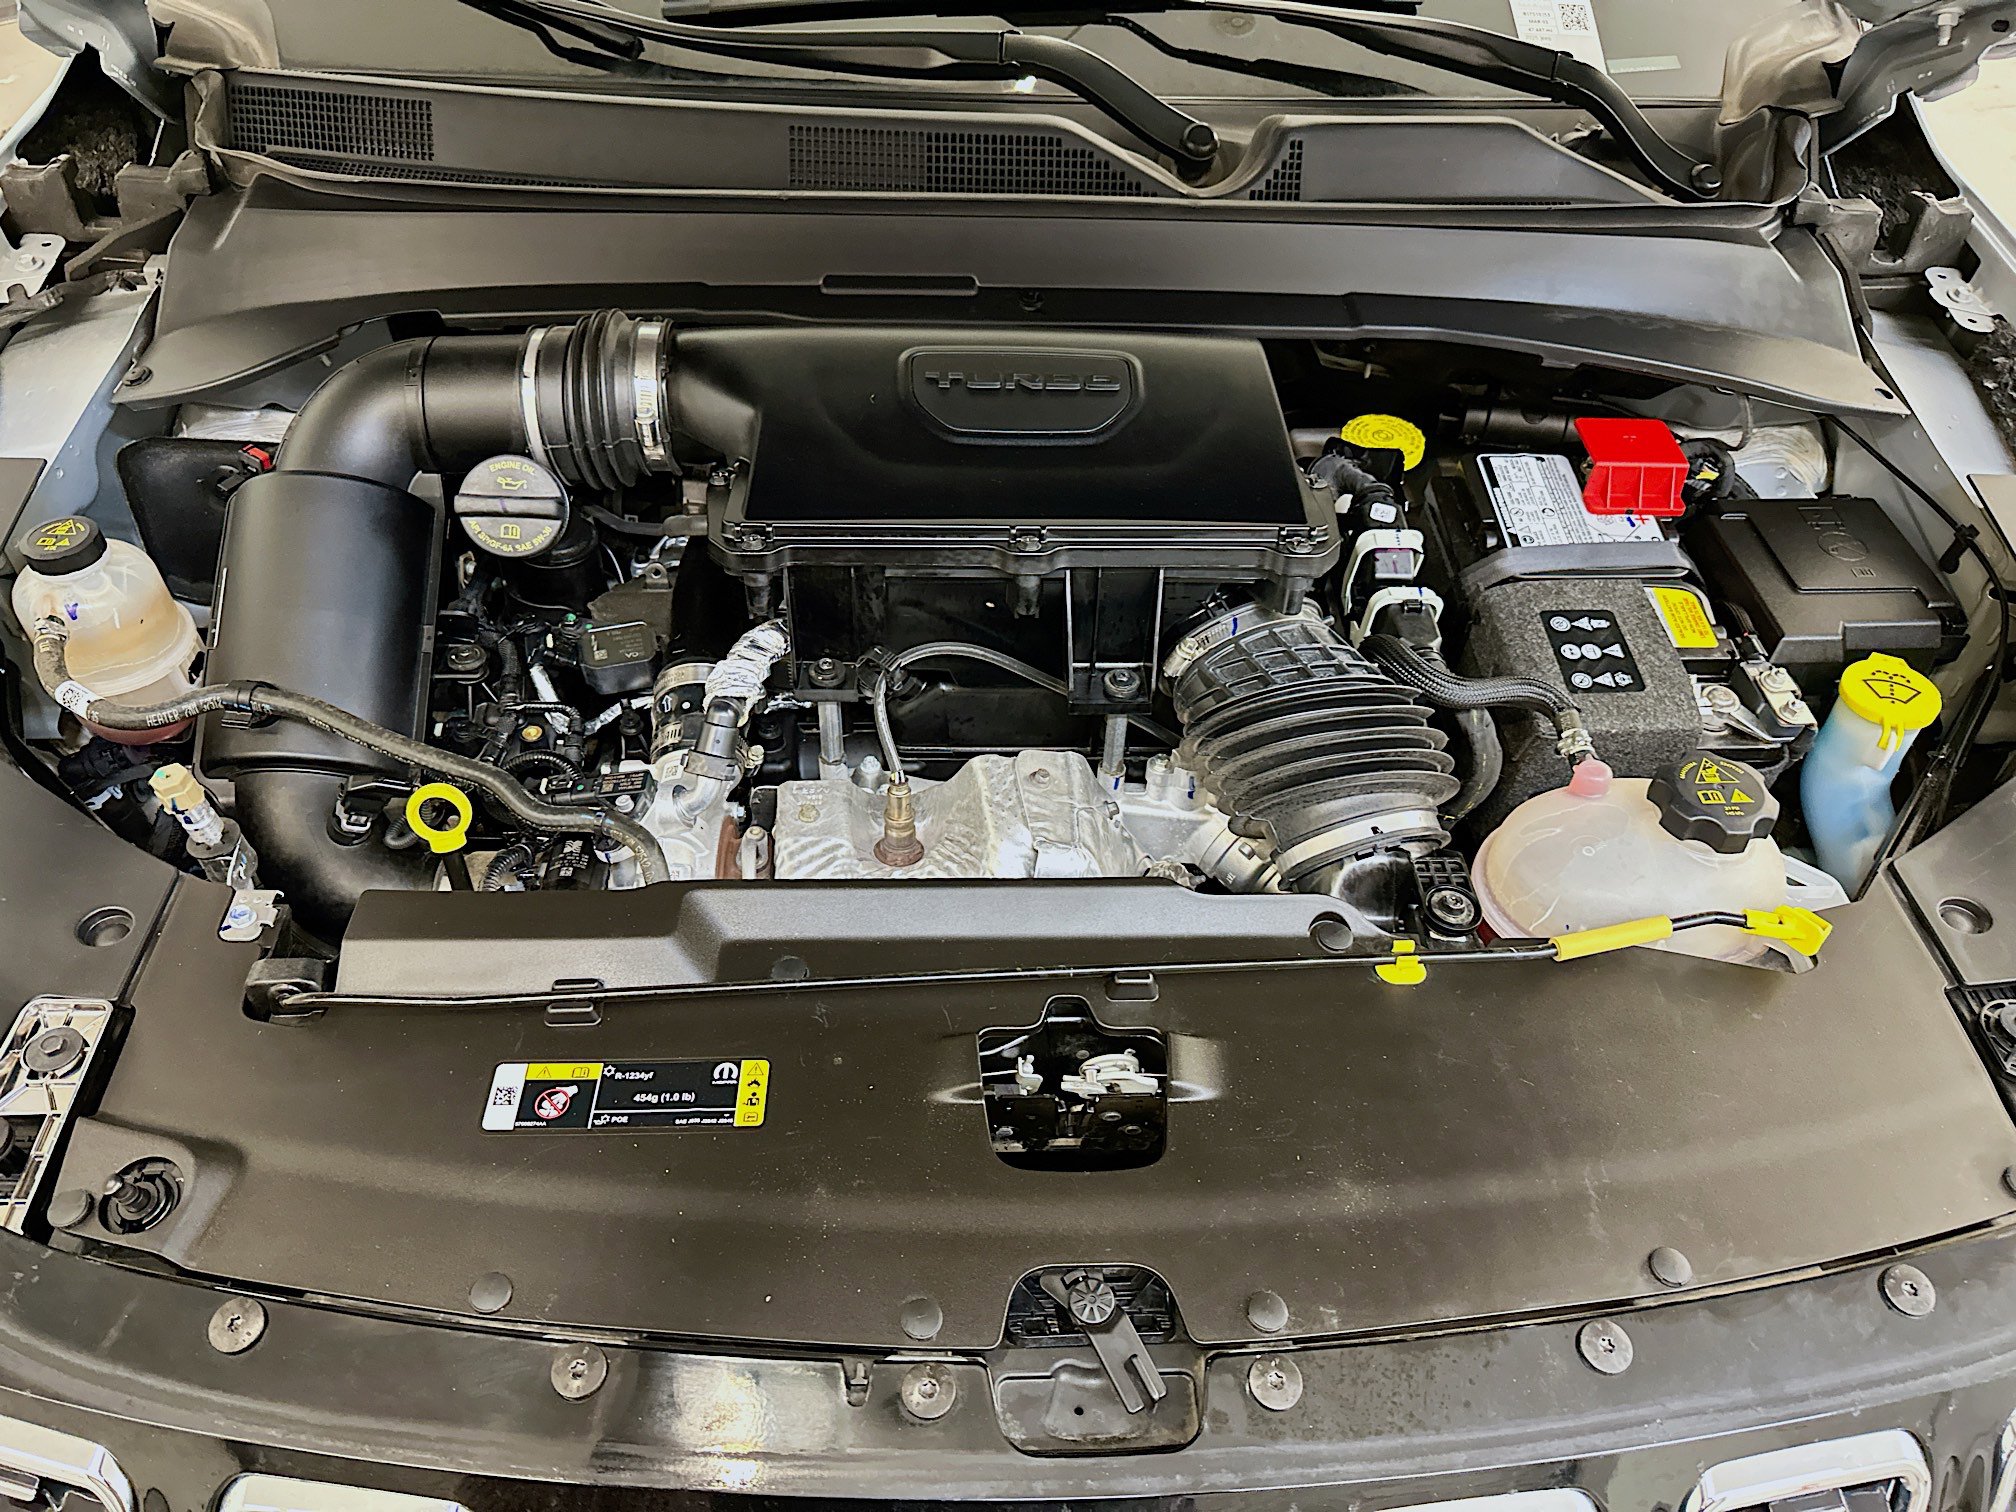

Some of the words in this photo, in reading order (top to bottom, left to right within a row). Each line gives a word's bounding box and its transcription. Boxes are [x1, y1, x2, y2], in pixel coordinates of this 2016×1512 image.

[924, 371, 1121, 391] TURBO
[488, 460, 521, 473] ENGINE
[521, 463, 536, 476] OIL
[468, 519, 481, 535] API
[515, 540, 534, 552] SAE
[145, 708, 180, 727] HEATER
[614, 1070, 654, 1081] R-1234yf
[633, 1093, 658, 1104] 454g
[660, 1092, 680, 1103] (1.0
[682, 1091, 696, 1103] lb)
[611, 1115, 628, 1124] POE
